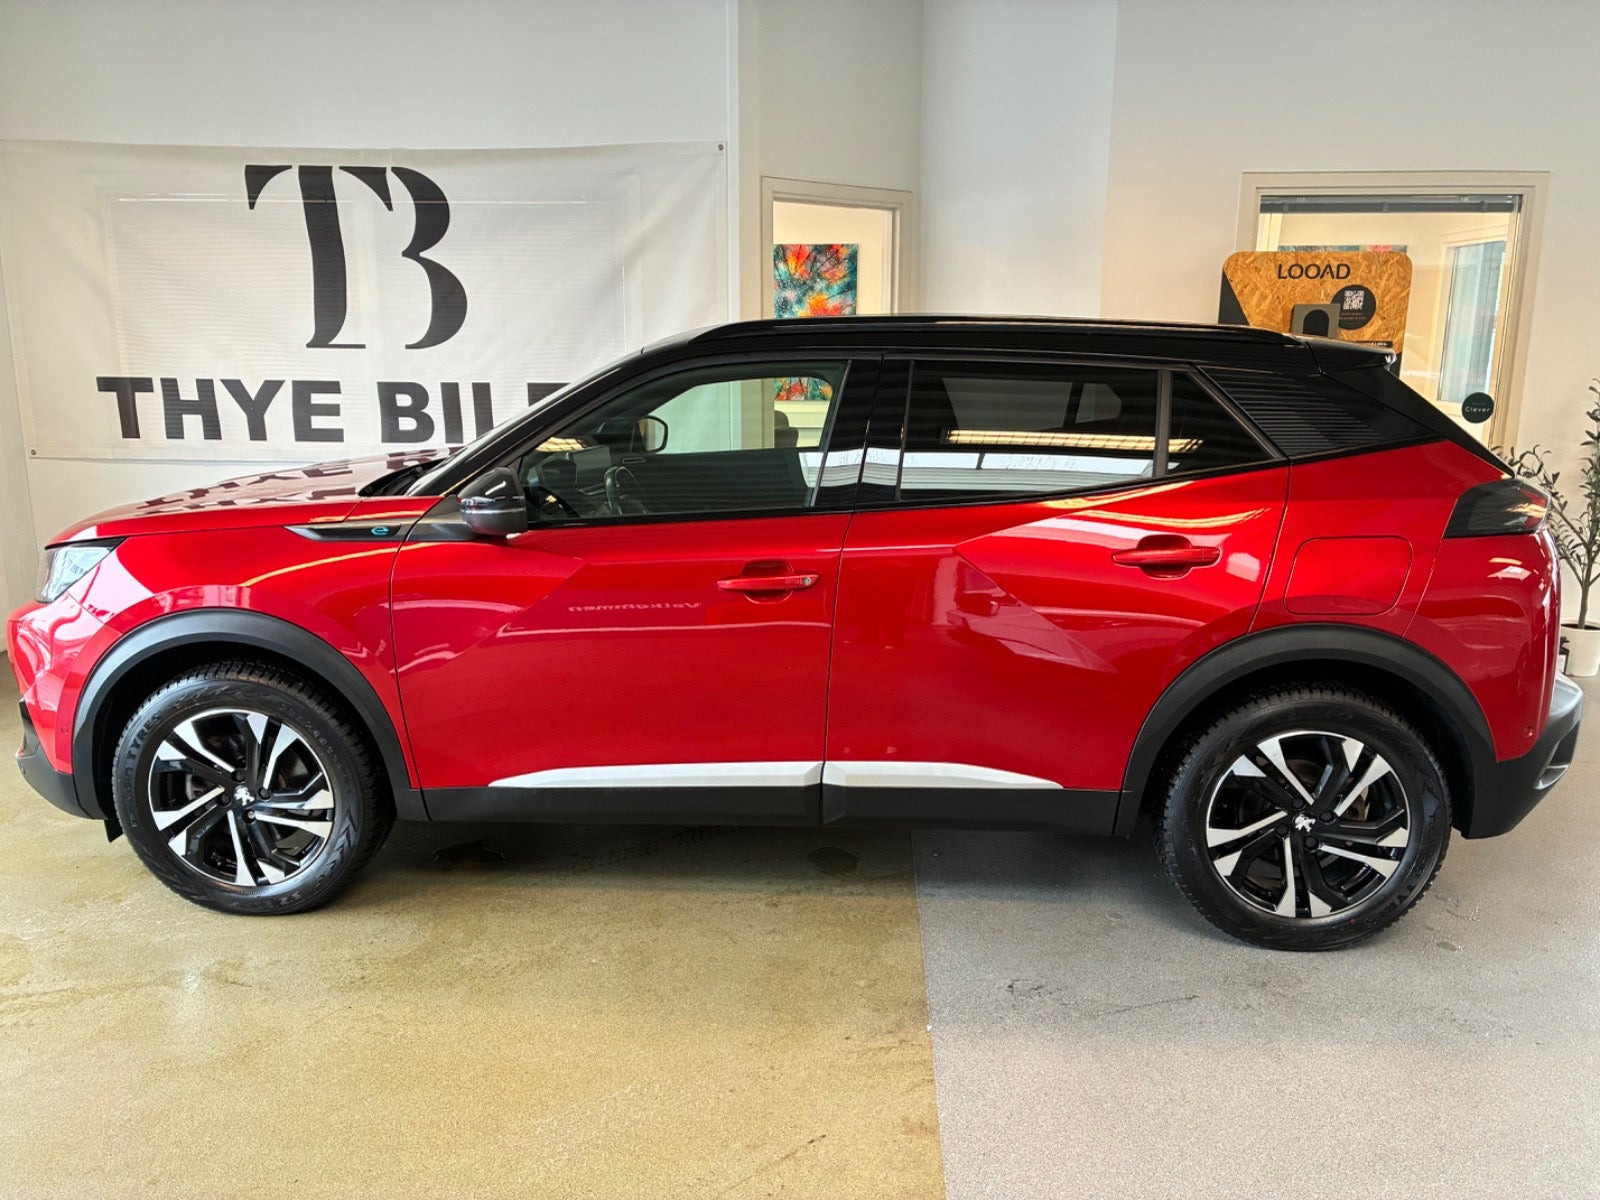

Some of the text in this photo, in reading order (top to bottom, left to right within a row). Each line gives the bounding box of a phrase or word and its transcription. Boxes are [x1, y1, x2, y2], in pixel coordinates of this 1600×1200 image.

[245, 164, 468, 350] TB
[1277, 262, 1351, 280] LOOAD
[96, 376, 571, 445] THYE BIL
